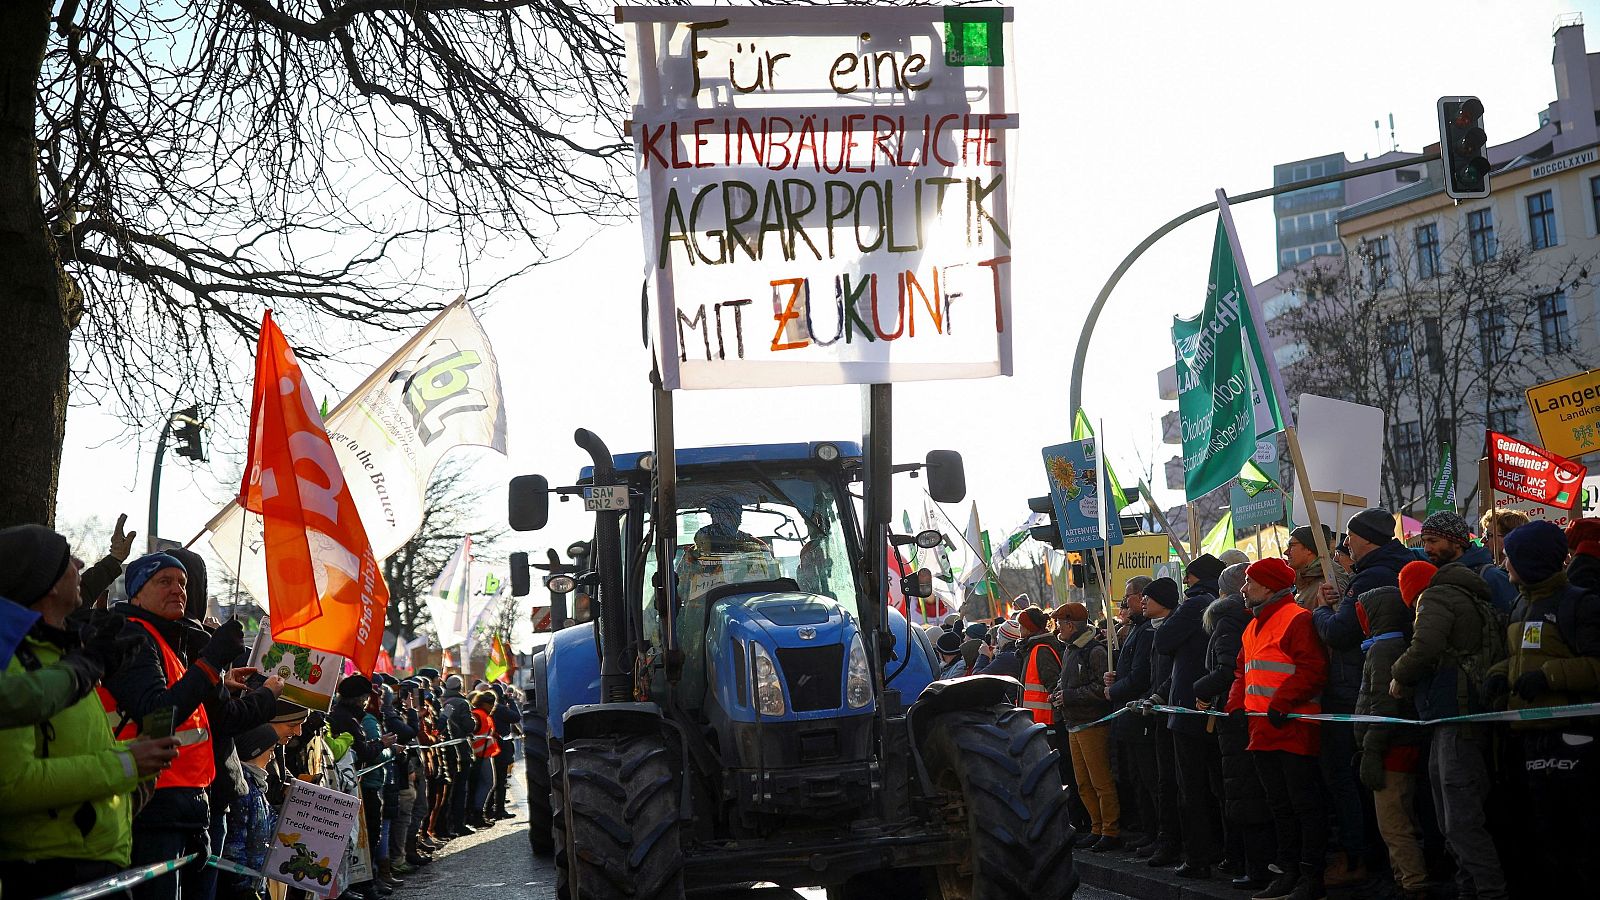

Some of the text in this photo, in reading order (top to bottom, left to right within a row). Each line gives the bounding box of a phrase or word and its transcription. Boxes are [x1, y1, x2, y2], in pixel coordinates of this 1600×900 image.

[686, 19, 933, 98] Für eine
[641, 113, 1009, 175] KLEINBÄUERLICHE
[1533, 151, 1594, 177] MDCCCLXXVII
[659, 173, 1012, 270] AGRARPOLITIK
[676, 256, 1012, 363] MIT ZUKUNFT
[346, 439, 359, 452] to
[356, 449, 375, 471] the
[1504, 453, 1550, 472] Patente?
[1497, 468, 1547, 488] BLEIBT UNS
[1498, 478, 1546, 500] VOM ACKER!
[592, 487, 614, 499] SAW
[1065, 523, 1115, 537] ARTENVIELLT
[289, 796, 354, 821] Sonst komme ich
[297, 786, 354, 809] Hört auf mich!
[285, 817, 345, 842] Trecker wieder!
[296, 810, 339, 829] mit meinem
